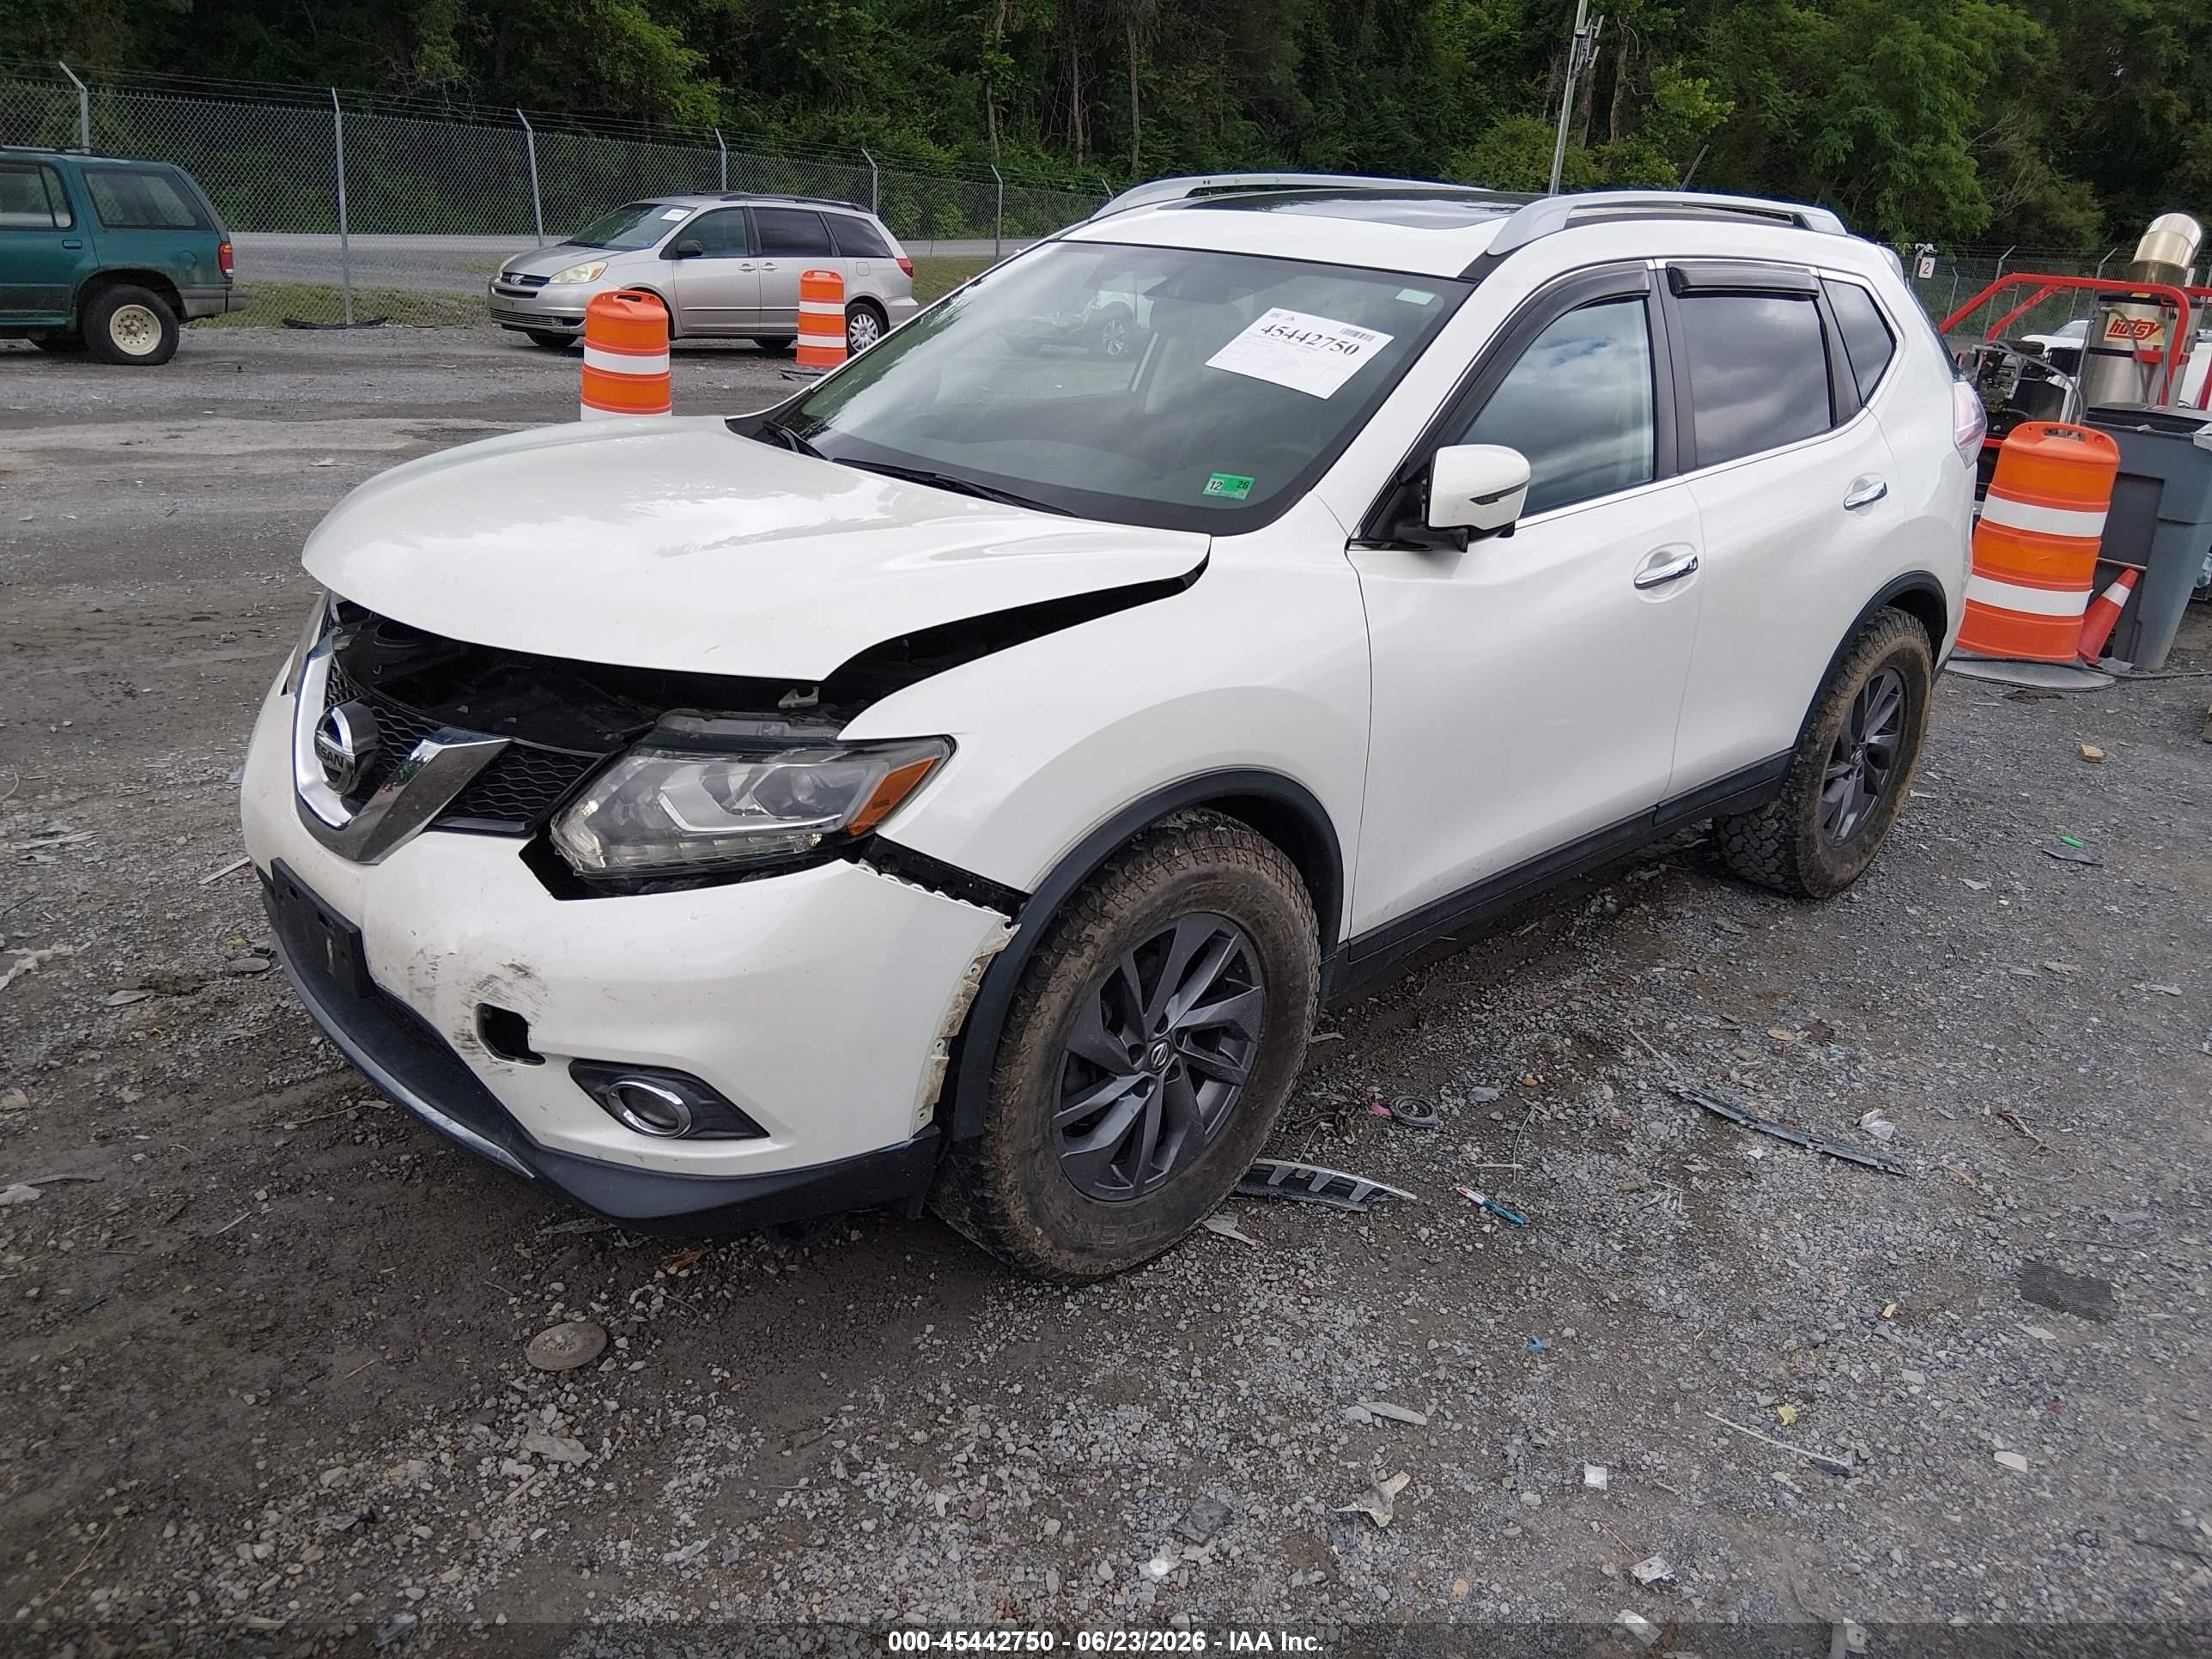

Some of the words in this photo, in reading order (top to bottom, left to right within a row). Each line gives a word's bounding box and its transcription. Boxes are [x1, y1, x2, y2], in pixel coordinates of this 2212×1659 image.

[1922, 260, 1931, 275] 2
[1261, 324, 1360, 356] 45442750
[1209, 480, 1223, 491] 12
